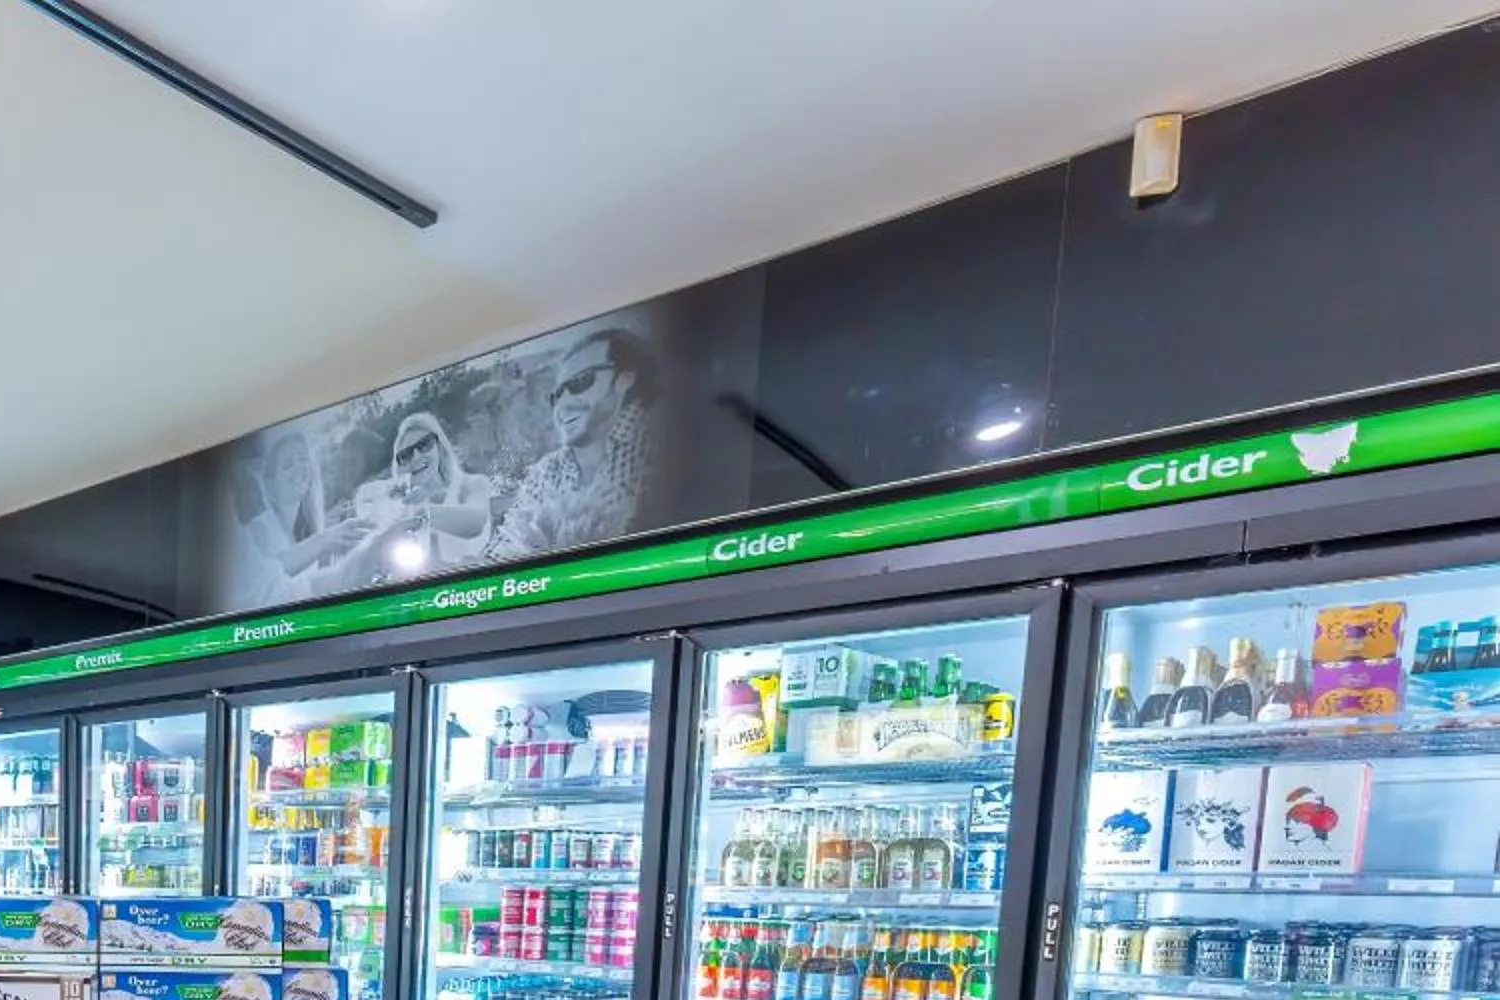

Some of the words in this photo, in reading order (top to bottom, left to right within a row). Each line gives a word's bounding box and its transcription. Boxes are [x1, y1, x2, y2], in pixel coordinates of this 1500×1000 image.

[1127, 450, 1268, 491] Cider
[713, 530, 803, 562] Cider
[433, 583, 497, 609] Ginger
[502, 575, 551, 597] Beer
[233, 618, 295, 644] Premix
[75, 650, 123, 670] Premix
[816, 656, 840, 673] 10
[129, 904, 160, 916] Over
[1043, 903, 1059, 959] PULL
[64, 981, 80, 996] 10
[128, 976, 159, 987] Over
